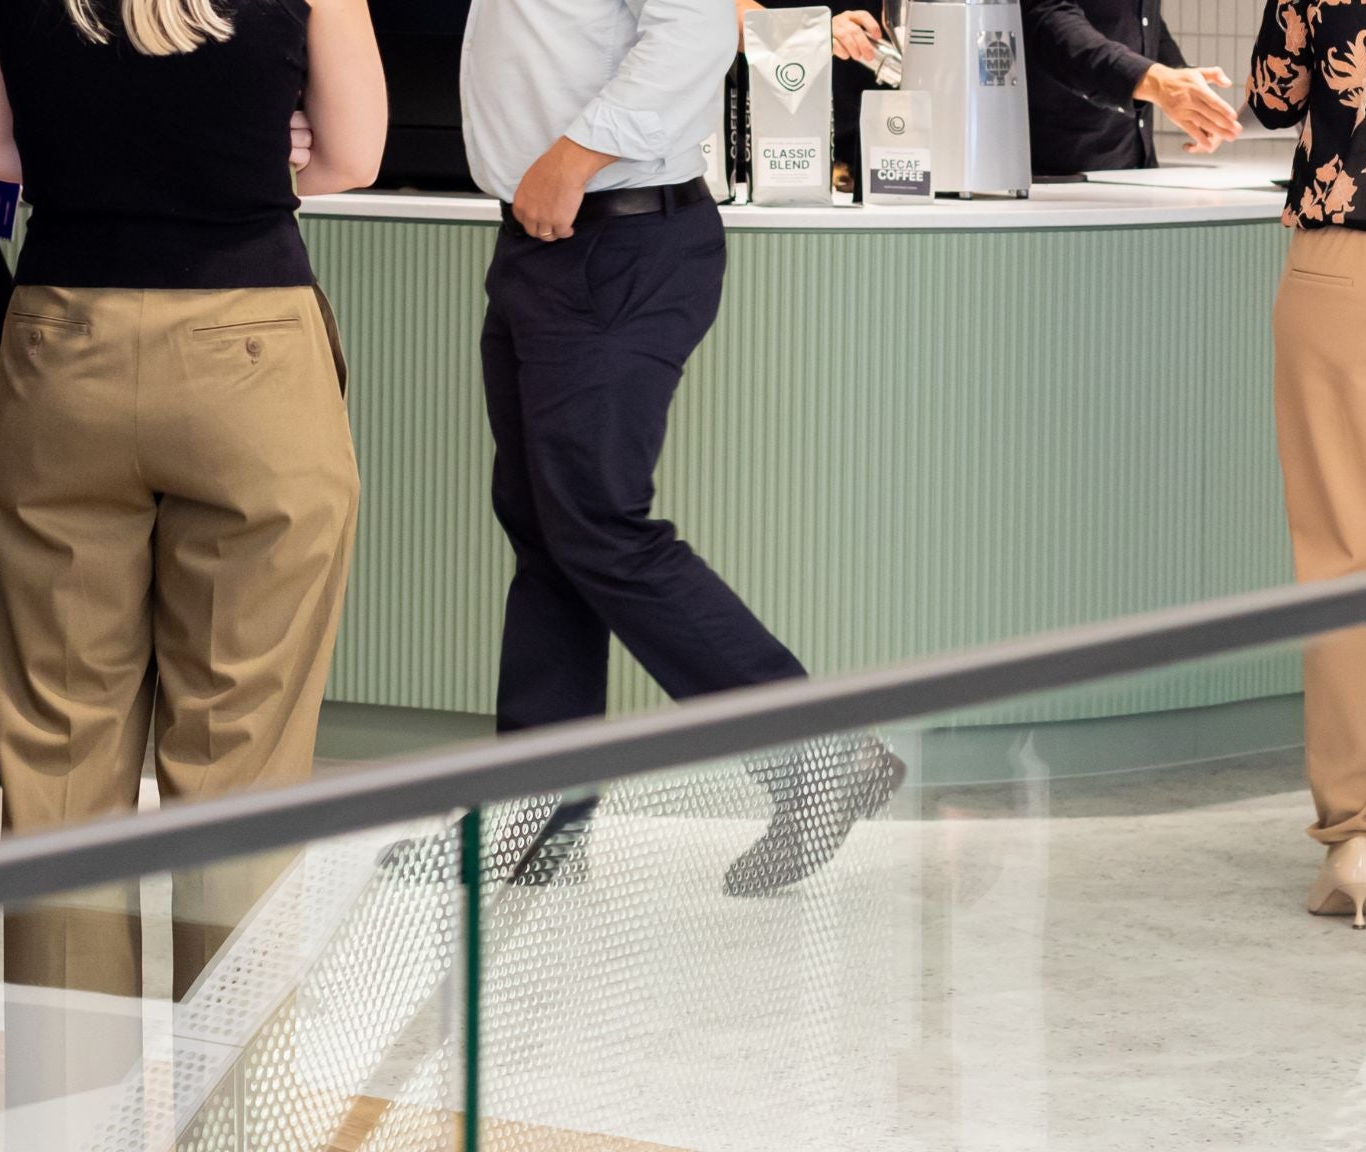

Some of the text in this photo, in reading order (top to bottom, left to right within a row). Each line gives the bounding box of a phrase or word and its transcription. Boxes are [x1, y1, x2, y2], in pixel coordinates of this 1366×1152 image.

[763, 148, 816, 159] CLASSIC
[770, 159, 810, 170] BLEND
[881, 159, 920, 169] DECAF
[878, 170, 923, 182] COFFEE
